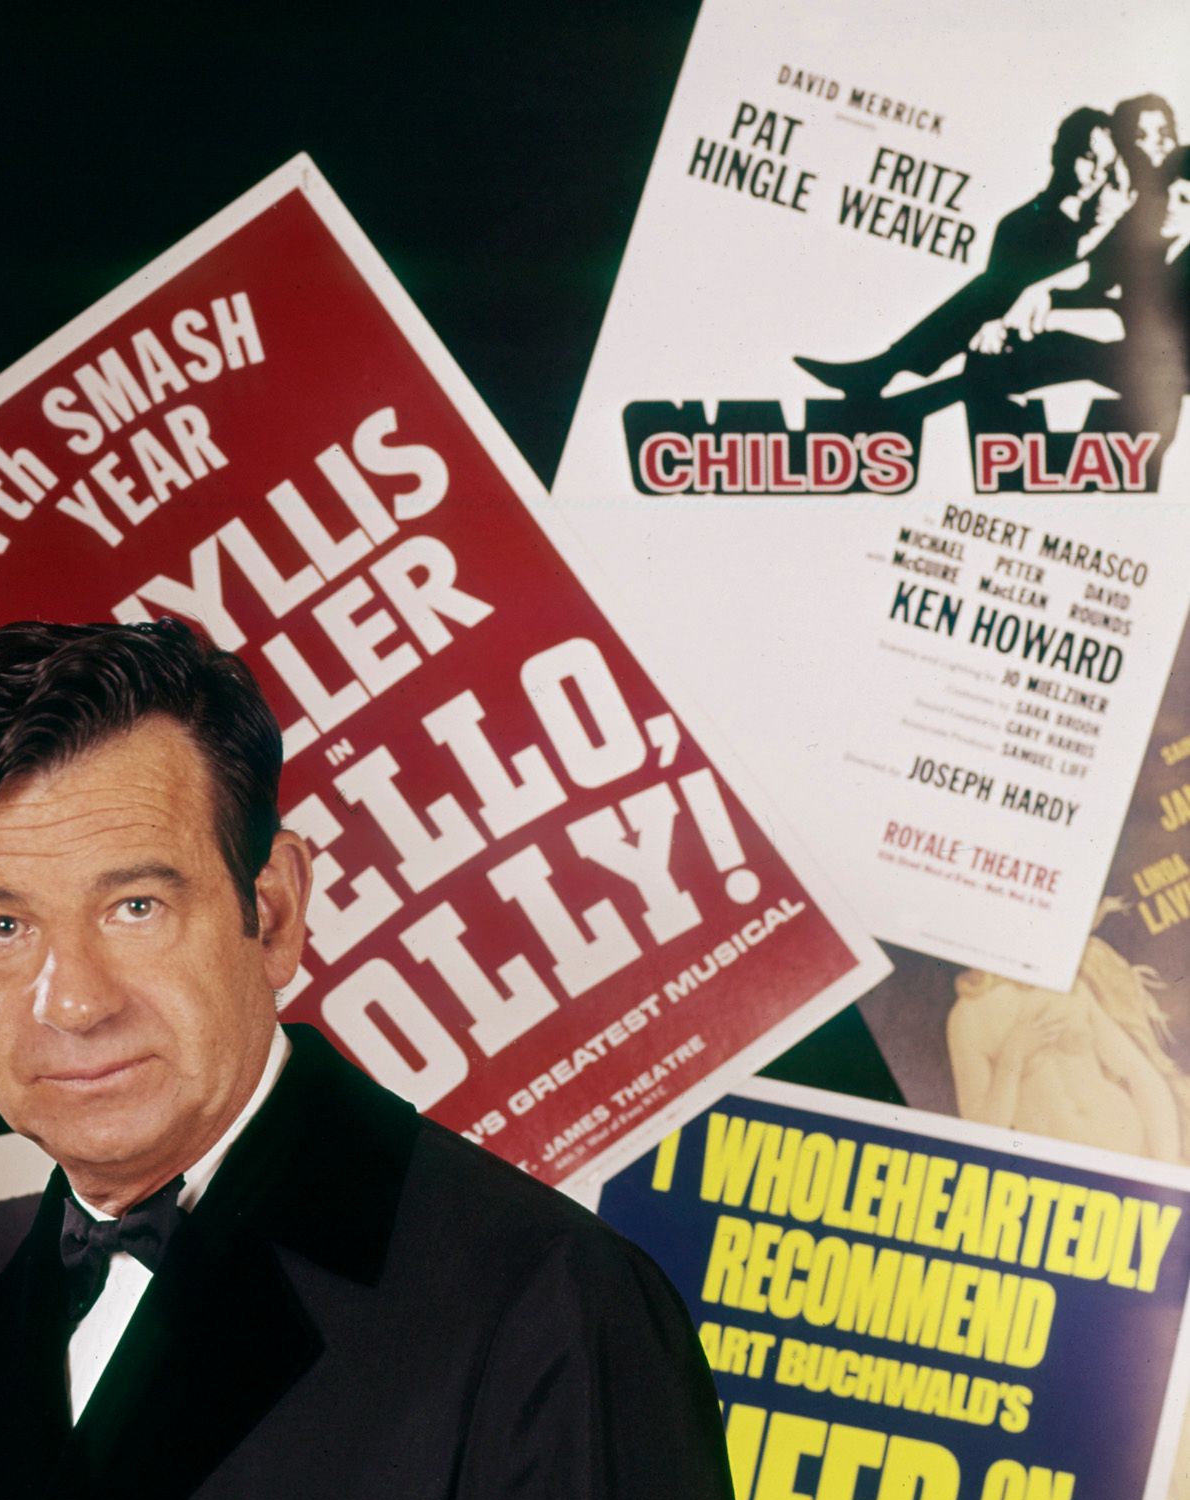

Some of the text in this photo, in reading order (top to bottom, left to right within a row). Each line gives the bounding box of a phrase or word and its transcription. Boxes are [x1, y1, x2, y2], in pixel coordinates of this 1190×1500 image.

[731, 102, 804, 156] PAT
[777, 64, 946, 134] DAVID MERRICK
[688, 137, 817, 213] HINGLE
[869, 147, 972, 212] FRITZ
[838, 186, 977, 264] WEAVER
[42, 291, 266, 455] SMASH
[56, 404, 230, 548] YEAR
[640, 432, 1161, 493] CHILD'S PLAY
[111, 406, 449, 653] YLLIS
[941, 504, 1149, 587] ROBERT MARASCO
[995, 555, 1046, 584] PETER
[889, 580, 963, 637] KEN
[970, 605, 1124, 684] HOWARD
[323, 737, 356, 766] IN
[907, 755, 996, 802] JOSEPH
[1001, 784, 1081, 827] HARDY
[277, 637, 682, 1012] ELLO,
[882, 820, 962, 865] ROYALE
[971, 845, 1062, 894] THEATRE
[507, 898, 806, 1117] GREATEST MUSICAL
[541, 1104, 611, 1162] JAMES
[611, 1035, 708, 1108] THEATRE
[700, 1111, 1182, 1294] WHOLEHEARTEDLY
[701, 1214, 1057, 1369] RECOMMEND
[699, 1322, 1033, 1433] ART BUCHWALD'S
